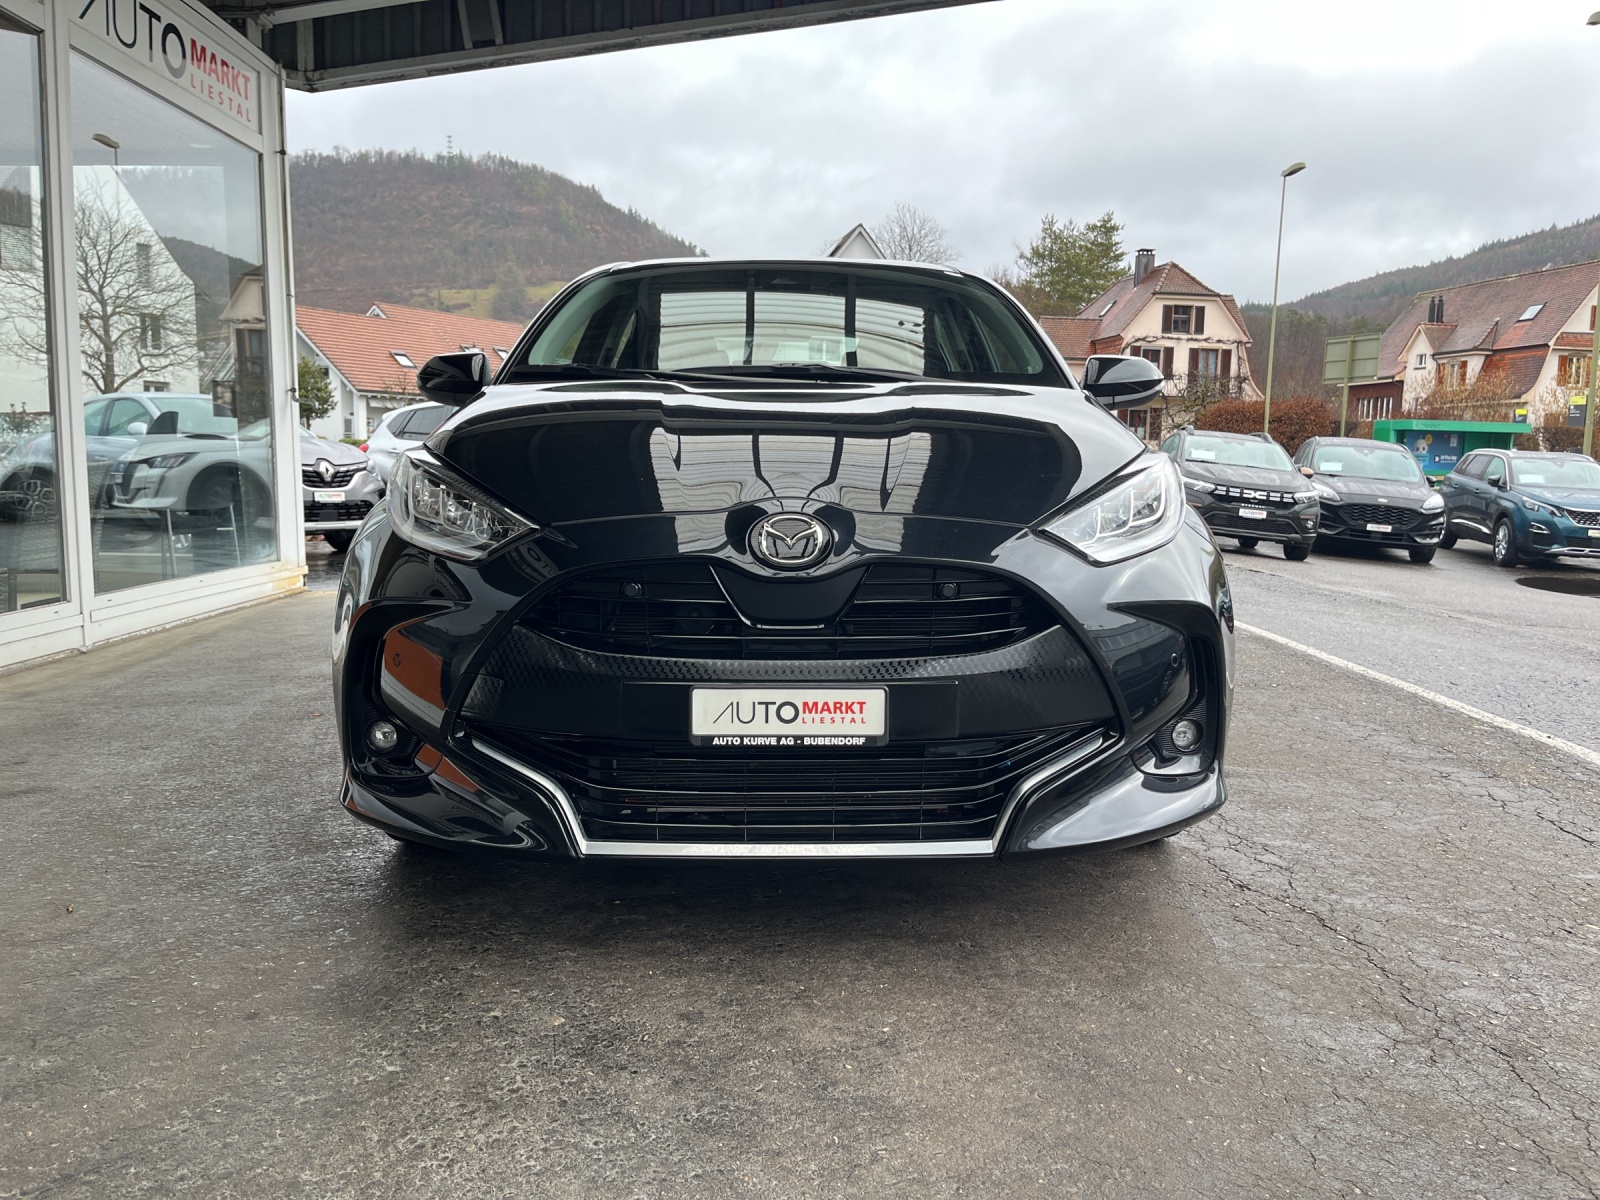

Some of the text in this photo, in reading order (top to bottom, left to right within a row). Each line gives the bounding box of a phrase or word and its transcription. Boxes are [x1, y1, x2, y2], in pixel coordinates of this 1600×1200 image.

[189, 37, 250, 101] MARKT
[190, 73, 251, 123] LIESTAL
[713, 701, 866, 724] AUTO MARKT
[712, 737, 741, 745] AUTO
[743, 737, 777, 745] KURVE
[780, 737, 794, 745] AG
[803, 737, 866, 745] BUBENDORF
